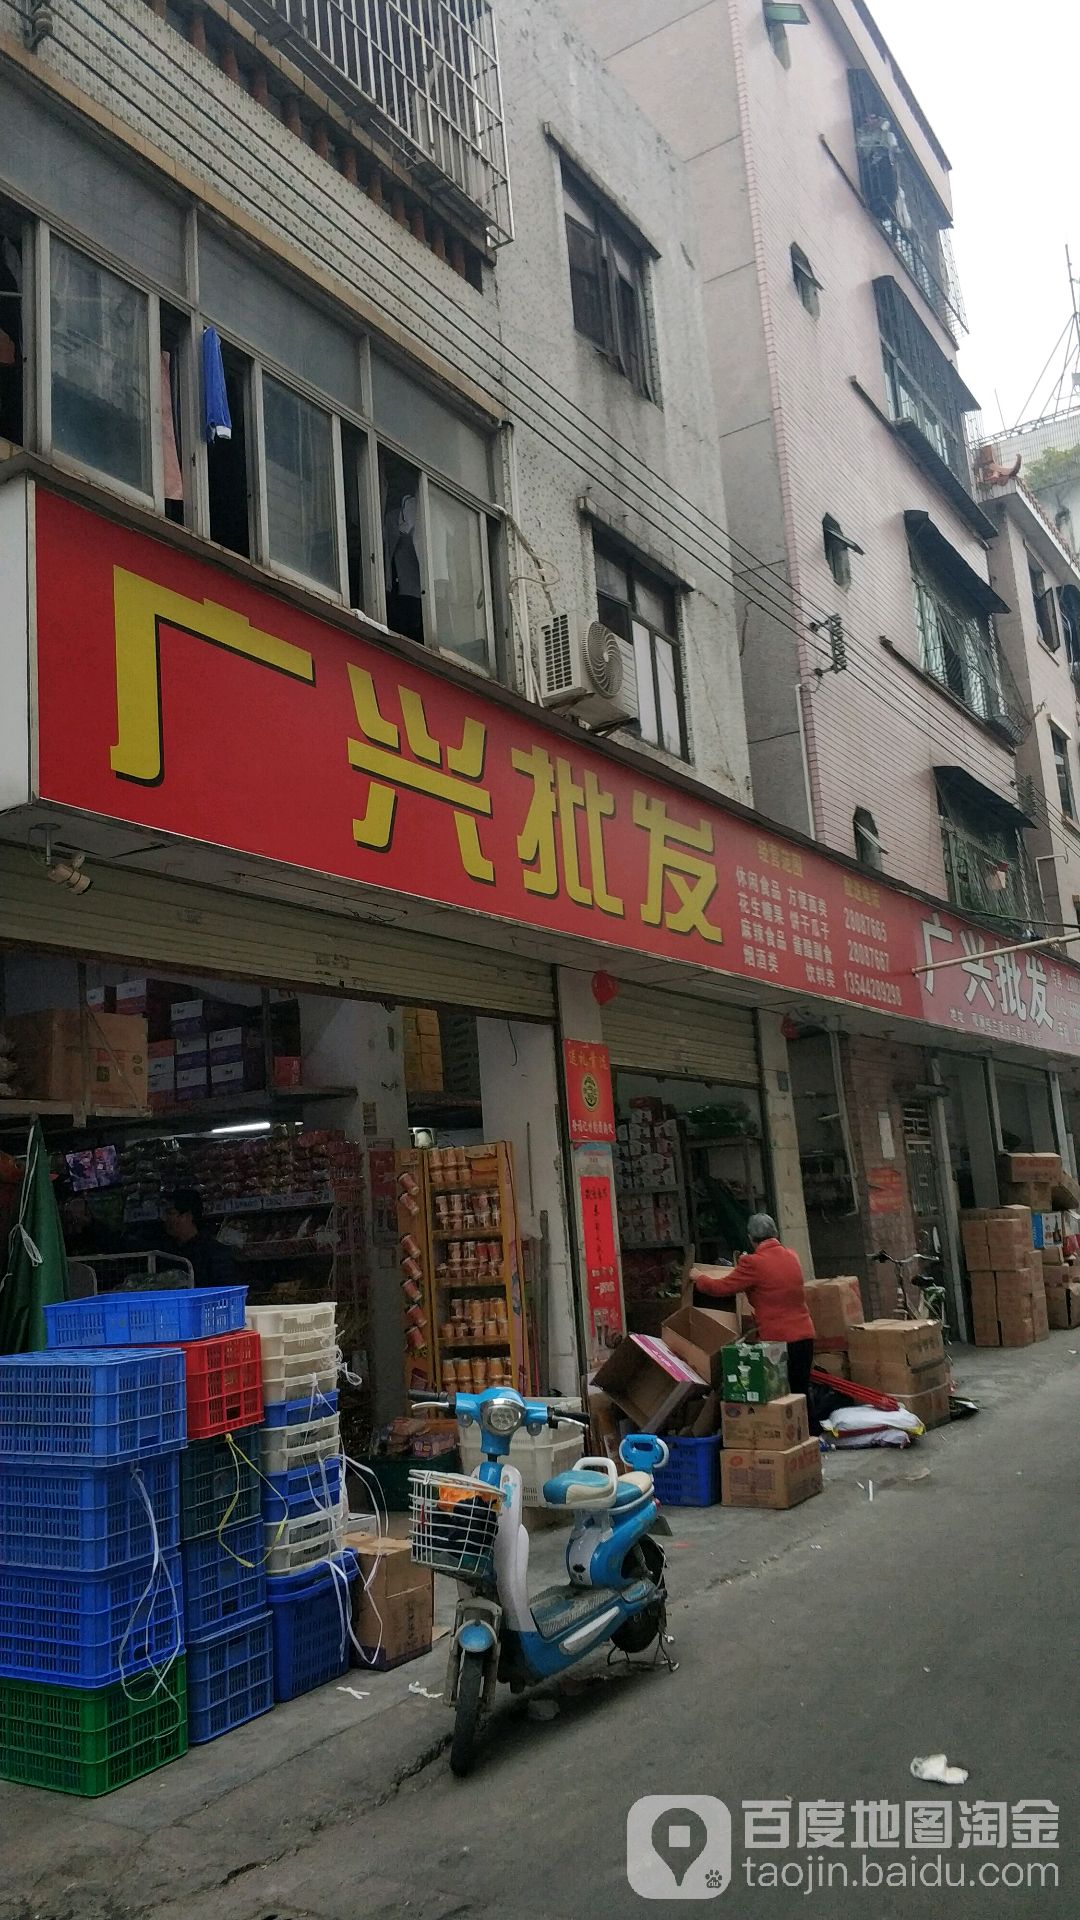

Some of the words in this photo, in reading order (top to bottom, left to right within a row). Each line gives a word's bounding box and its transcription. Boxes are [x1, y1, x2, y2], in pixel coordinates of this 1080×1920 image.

[111, 565, 723, 943] 广兴批发
[735, 865, 782, 900] 休闲食品
[737, 892, 785, 926] 花生糖果
[789, 910, 830, 940] 饼干瓜子
[740, 917, 787, 951] 麻辣食品
[743, 945, 779, 974] 烟酒类
[805, 963, 836, 989] 饮料类
[922, 912, 1054, 1031] 广兴批发
